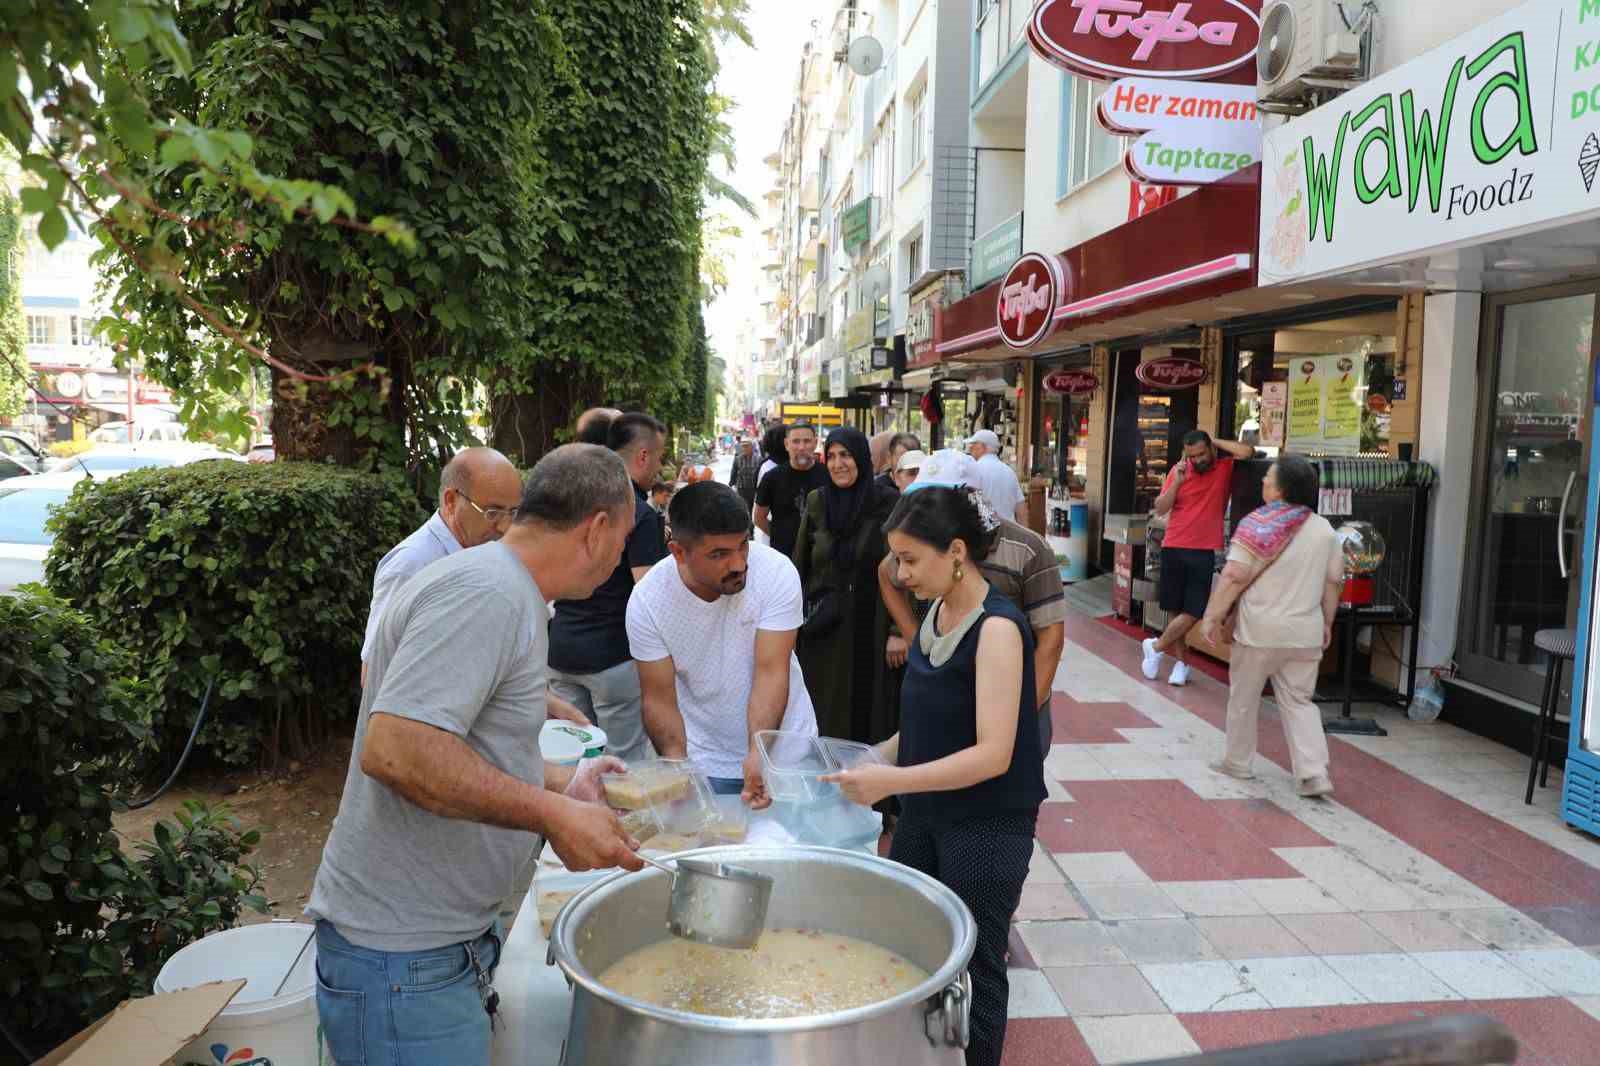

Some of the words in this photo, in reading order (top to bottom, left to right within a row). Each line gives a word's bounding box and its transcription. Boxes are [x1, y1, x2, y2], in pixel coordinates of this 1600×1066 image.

[1112, 85, 1161, 113] Her
[1165, 96, 1257, 121] zaman
[1144, 142, 1253, 173] Taptaze
[1446, 167, 1535, 220] Foodz
